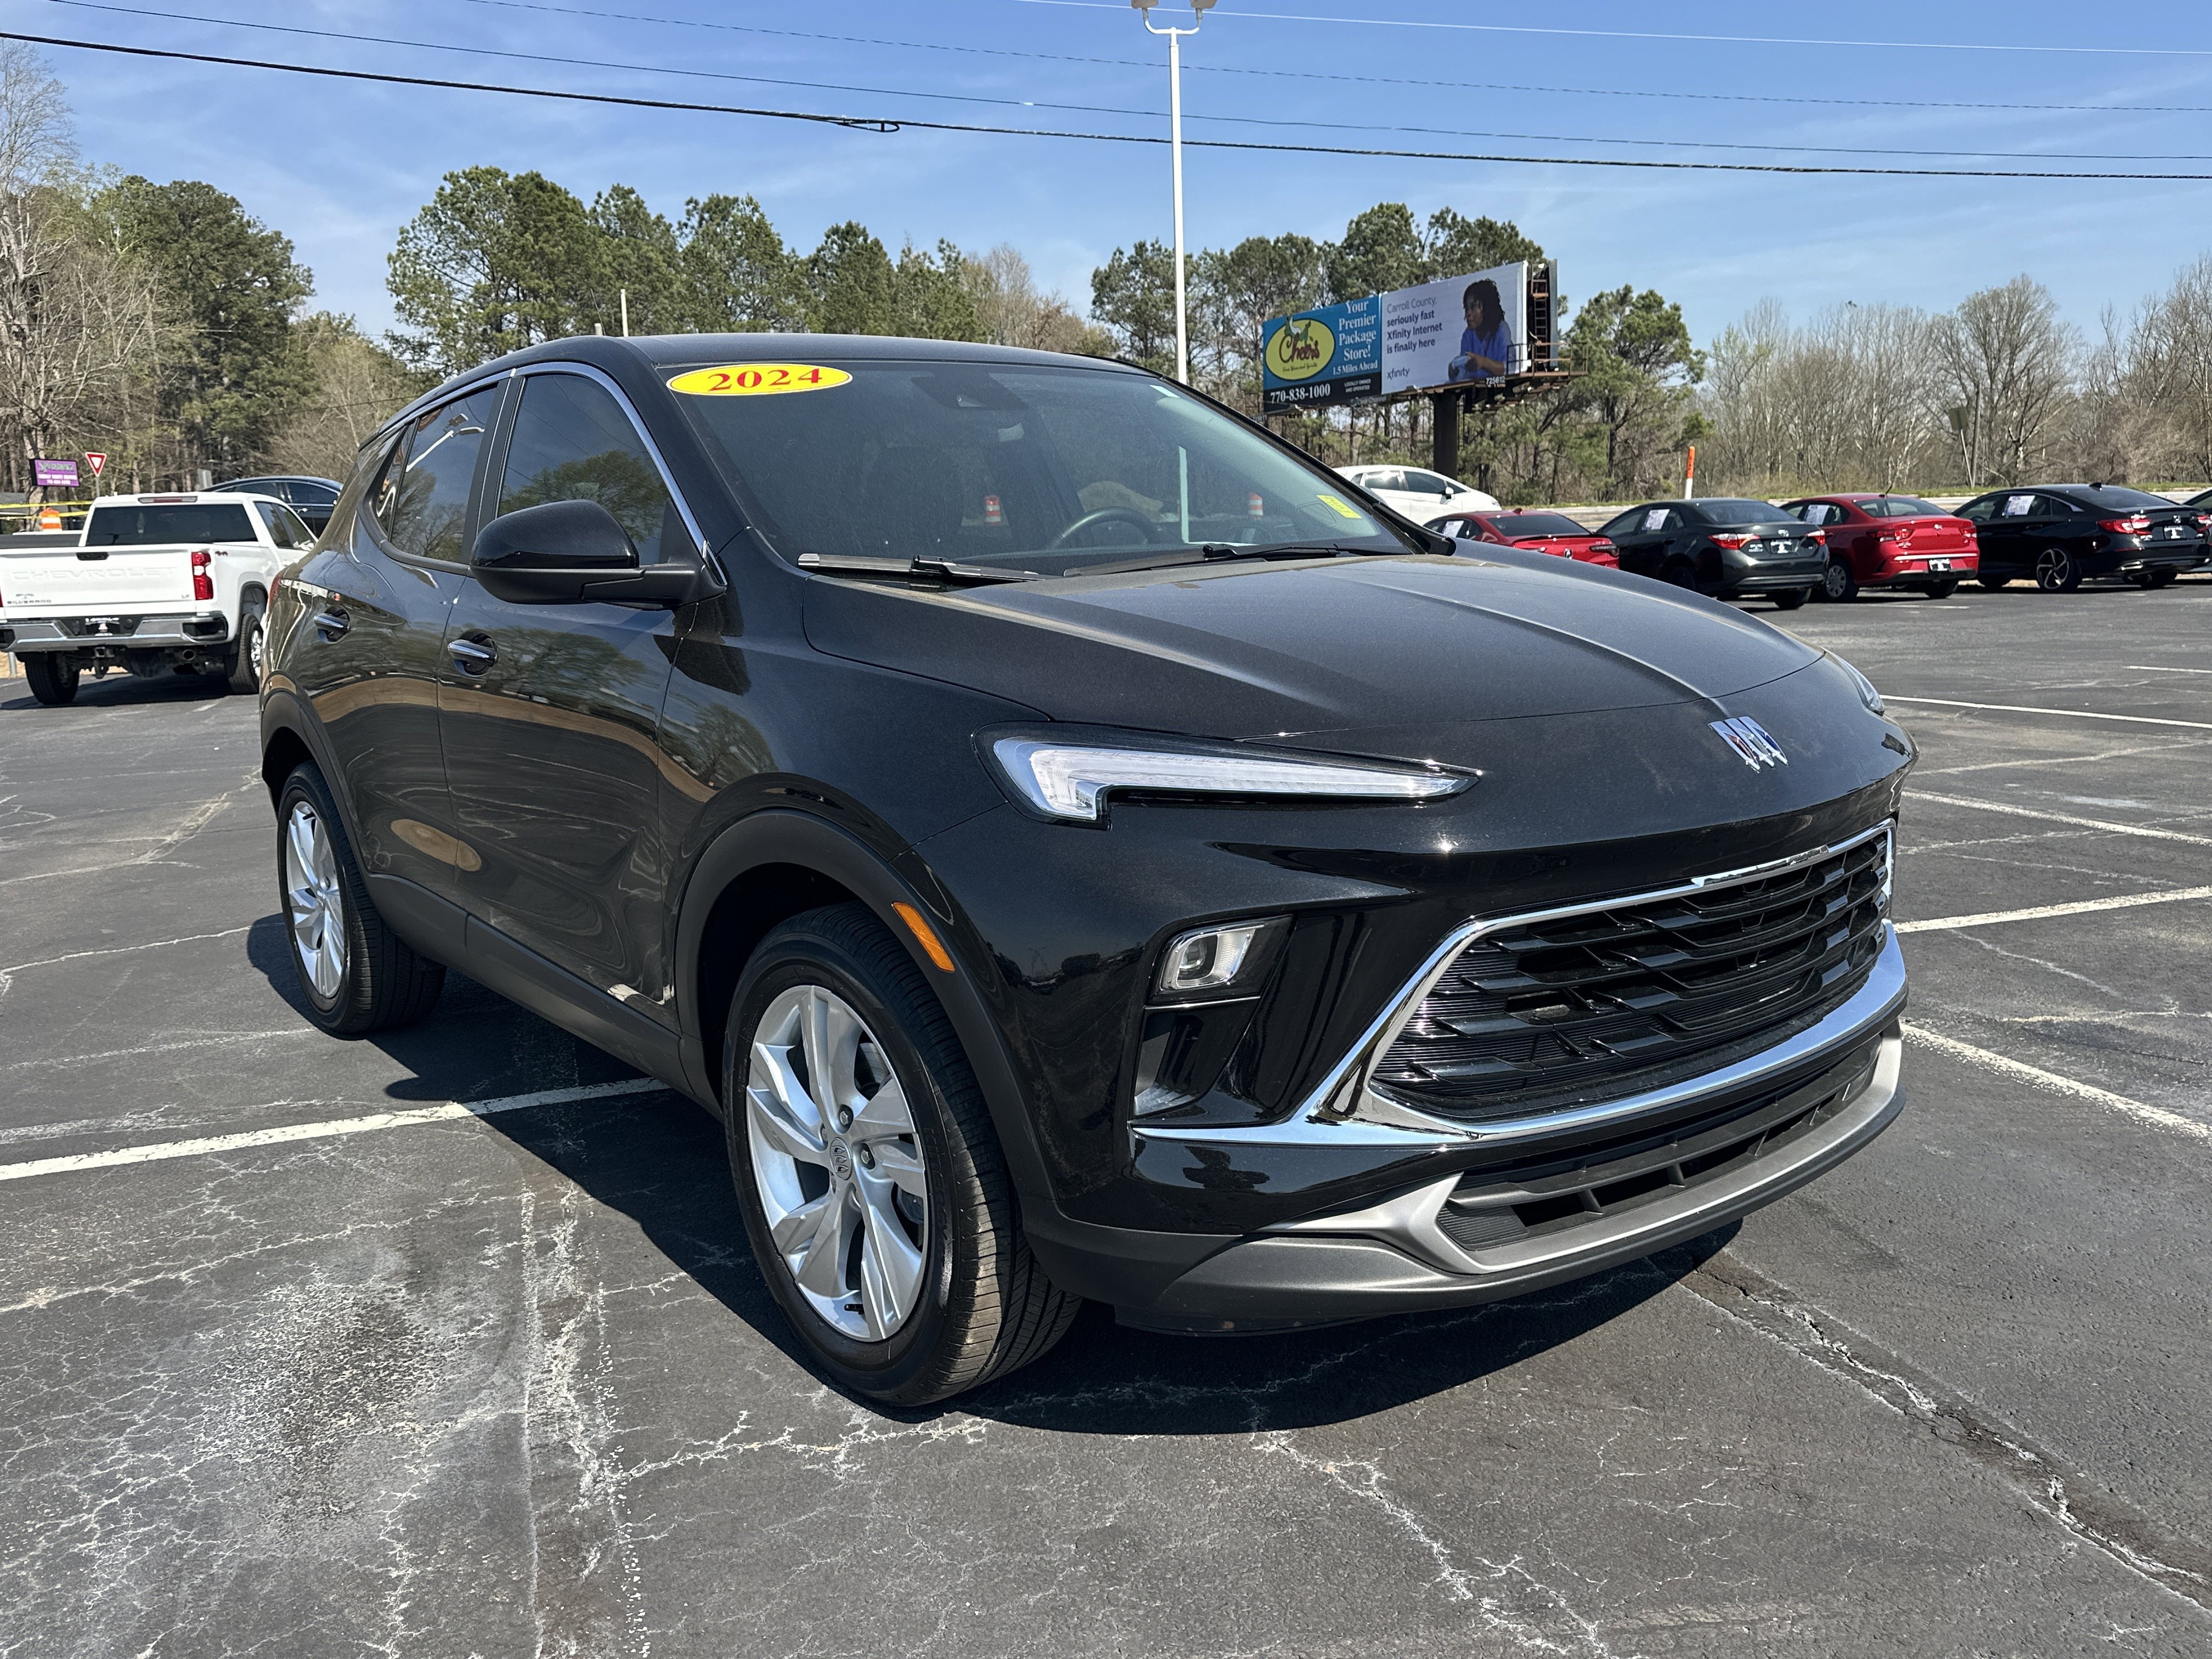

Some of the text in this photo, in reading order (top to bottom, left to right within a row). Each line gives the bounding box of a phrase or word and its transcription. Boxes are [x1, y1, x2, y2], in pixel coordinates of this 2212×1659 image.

[1346, 300, 1369, 314] Your
[1387, 300, 1409, 313] Carroll
[1339, 314, 1376, 331] Premier
[1387, 310, 1435, 327] seriously fast
[1339, 330, 1376, 346] Package
[1387, 322, 1442, 341] Xfinity Internet
[1344, 345, 1371, 361] Store!
[1387, 338, 1435, 354] is finally here
[1342, 363, 1358, 374] Miles
[1359, 360, 1378, 372] Ahead
[1387, 367, 1410, 380] xfinity
[708, 368, 822, 391] 2024
[1270, 383, 1330, 404] 770-838-1000
